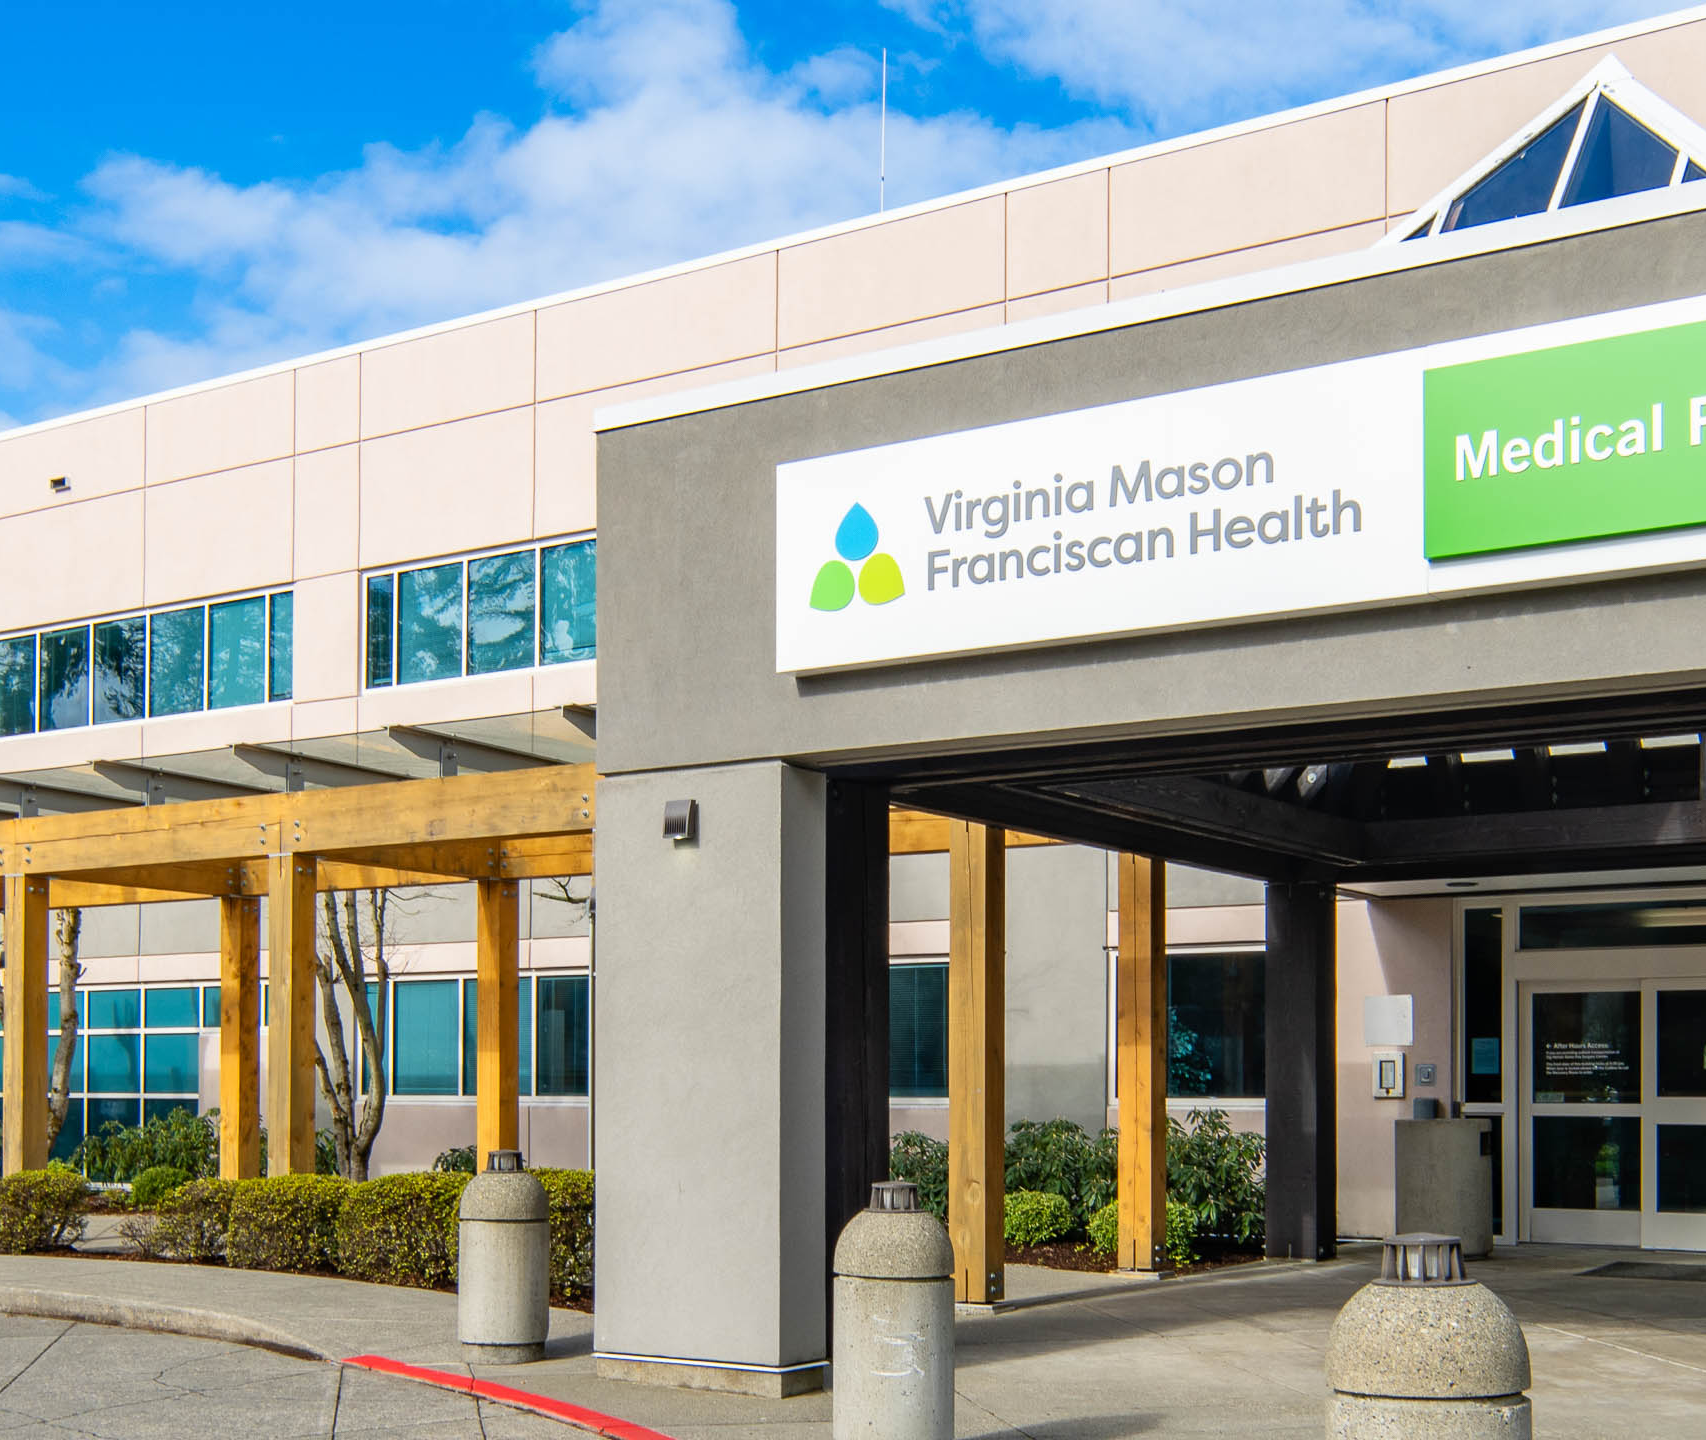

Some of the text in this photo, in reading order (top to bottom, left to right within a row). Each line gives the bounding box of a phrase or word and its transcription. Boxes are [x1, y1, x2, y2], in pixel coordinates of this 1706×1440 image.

[1454, 401, 1664, 482] Medical
[924, 450, 1275, 539] Virginia Mason
[927, 489, 1363, 591] Franciscan Health
